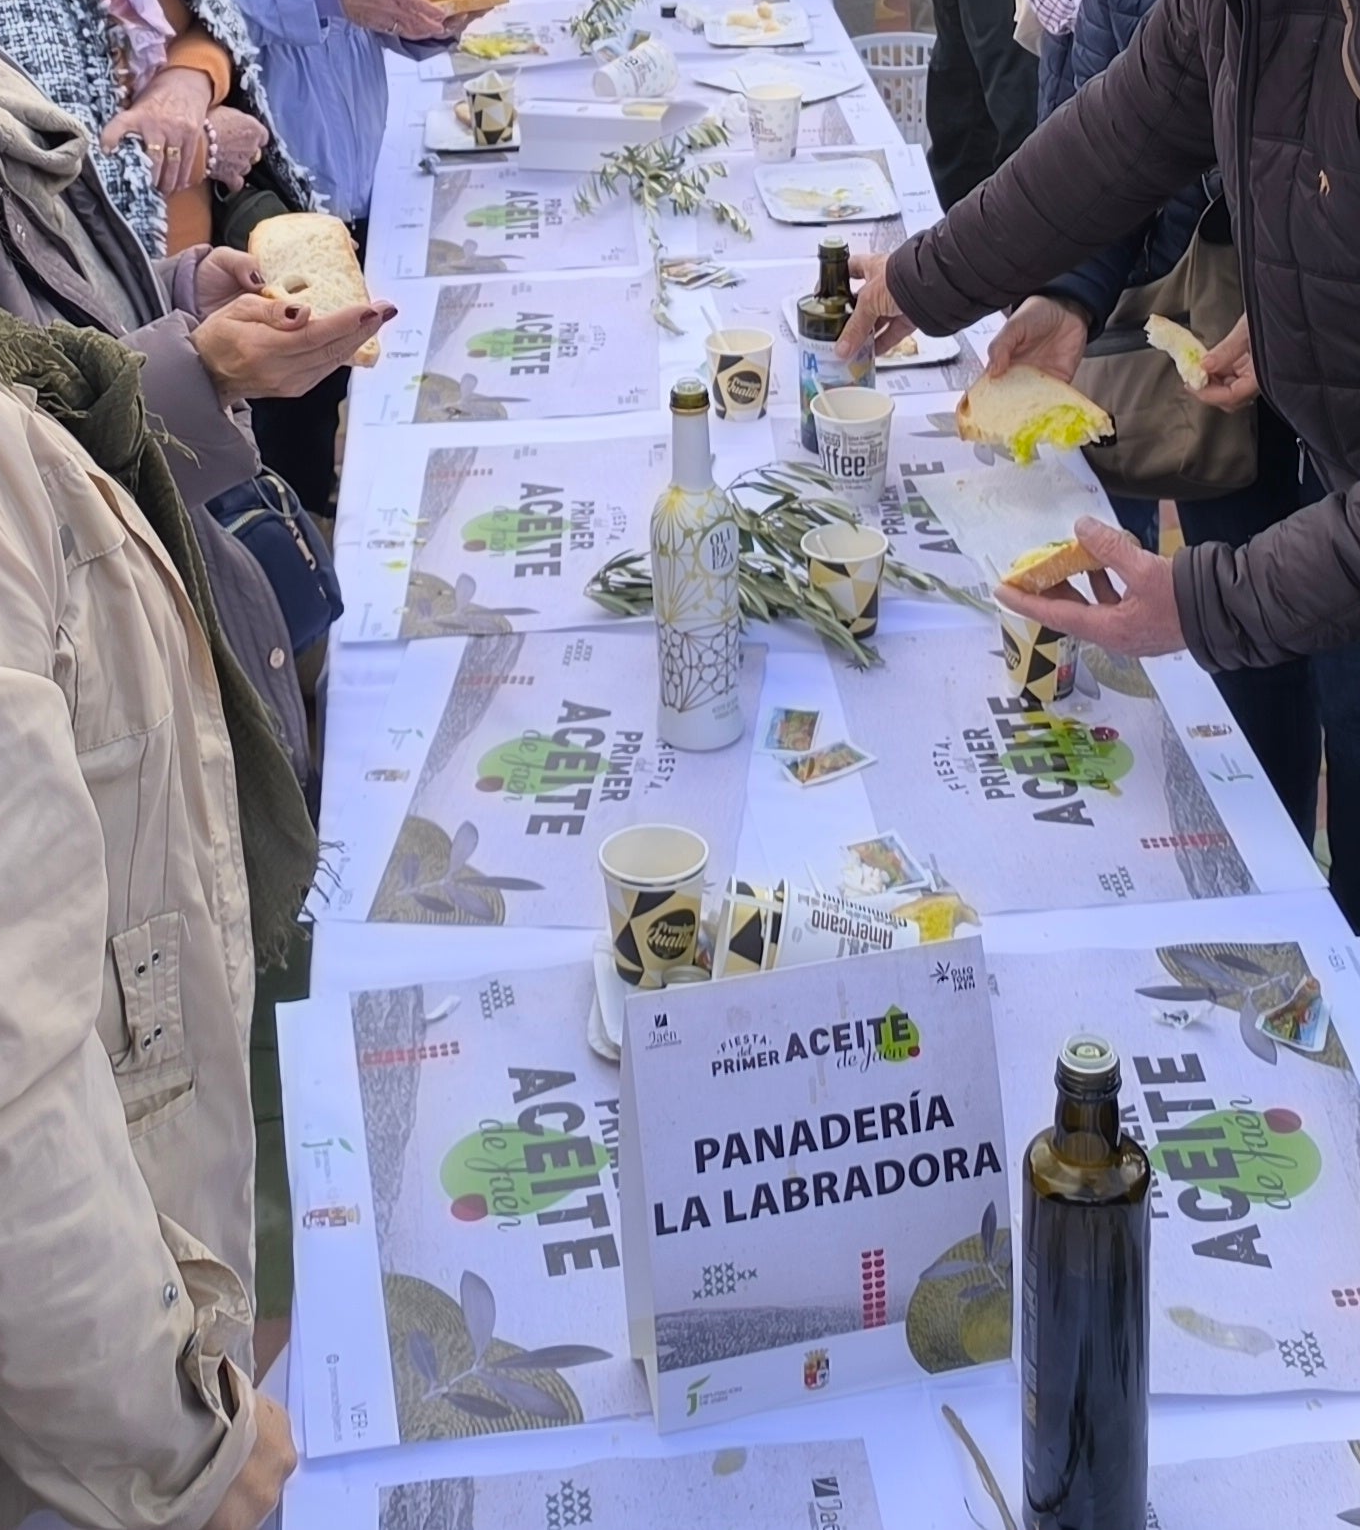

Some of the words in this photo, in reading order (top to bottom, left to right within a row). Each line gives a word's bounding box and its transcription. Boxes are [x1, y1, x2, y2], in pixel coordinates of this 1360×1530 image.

[504, 190, 540, 241] ACEITE
[509, 311, 554, 376] ACEITE
[557, 322, 579, 358] PRIMER
[514, 482, 564, 579] ACEITE
[569, 500, 595, 551] PRIMER
[709, 527, 731, 547] OLI
[525, 699, 612, 836] ACEITE
[598, 730, 644, 803] PRIMER
[933, 742, 963, 792] FIESTA
[962, 727, 1015, 801] PRIMER
[987, 696, 1095, 827] ACEITE
[811, 909, 894, 950] Americano
[951, 965, 974, 977] OLEO
[952, 973, 975, 984] TOUR
[648, 1029, 678, 1045] Jaén
[711, 1049, 780, 1077] PRIMER
[785, 1012, 912, 1063] ACEITE
[720, 1033, 768, 1053] FIESTA
[836, 1044, 859, 1070] de
[859, 1038, 905, 1073] Jaén
[694, 1090, 955, 1174] PANADERÍA
[1133, 1053, 1273, 1269] ACEITE
[1223, 1095, 1299, 1169] Jaén
[463, 1156, 532, 1232] Jaén
[508, 1067, 621, 1277] ACEITE
[653, 1195, 711, 1237] LA
[723, 1141, 1002, 1224] LABRADORA
[349, 1401, 369, 1431] VER
